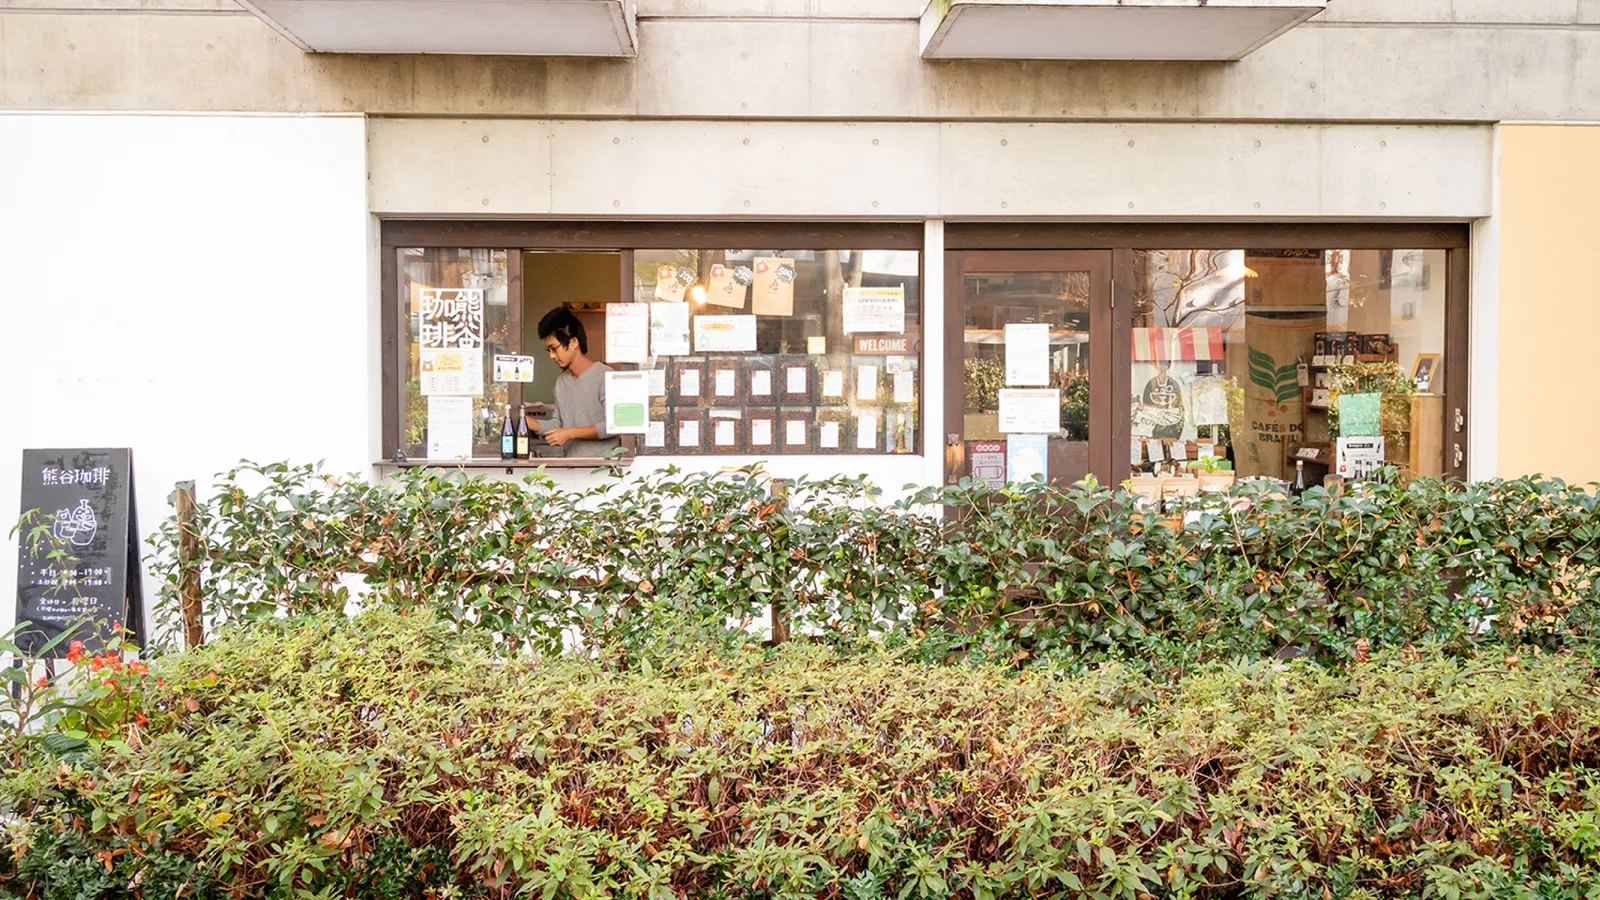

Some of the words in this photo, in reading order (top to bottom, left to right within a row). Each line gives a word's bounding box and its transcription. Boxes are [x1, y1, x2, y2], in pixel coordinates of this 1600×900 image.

[859, 338, 907, 352] WELCOME
[1252, 420, 1286, 433] CAFÉS
[41, 466, 111, 486] 熊谷珈琲
